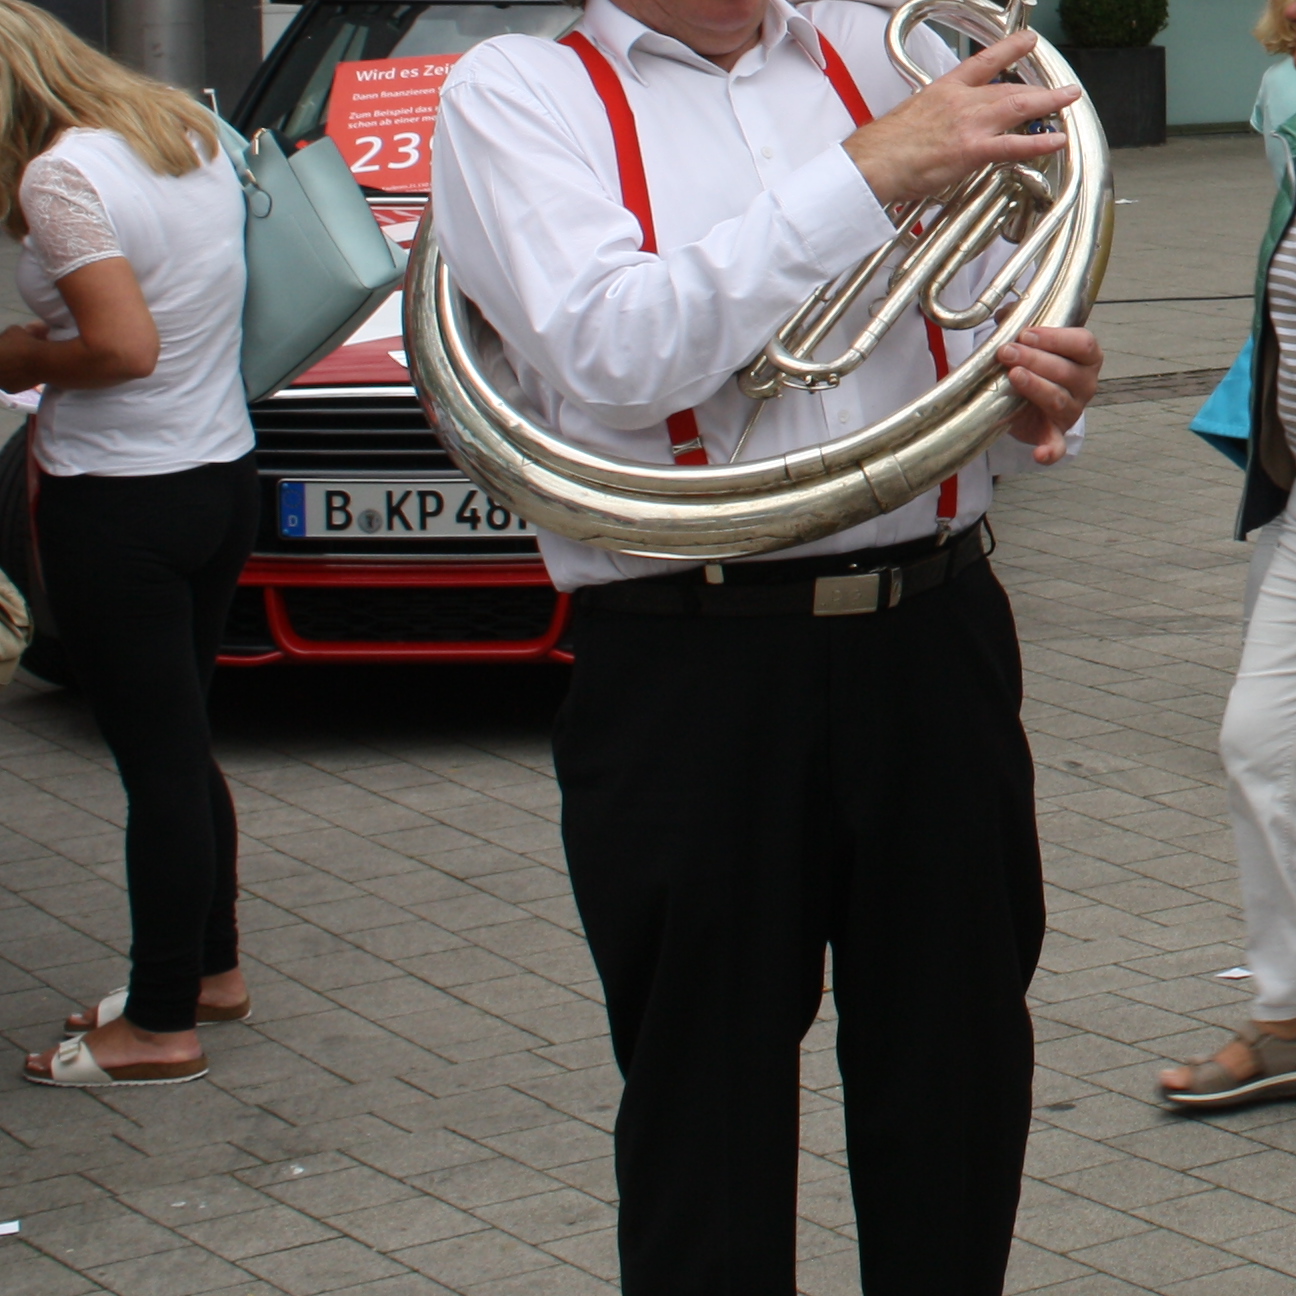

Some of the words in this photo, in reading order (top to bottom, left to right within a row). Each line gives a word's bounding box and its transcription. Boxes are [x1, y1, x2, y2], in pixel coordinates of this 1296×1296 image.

[356, 68, 396, 82] Wird
[400, 68, 419, 79] es
[325, 489, 353, 532] B
[386, 489, 444, 532] KP
[455, 489, 529, 532] 48
